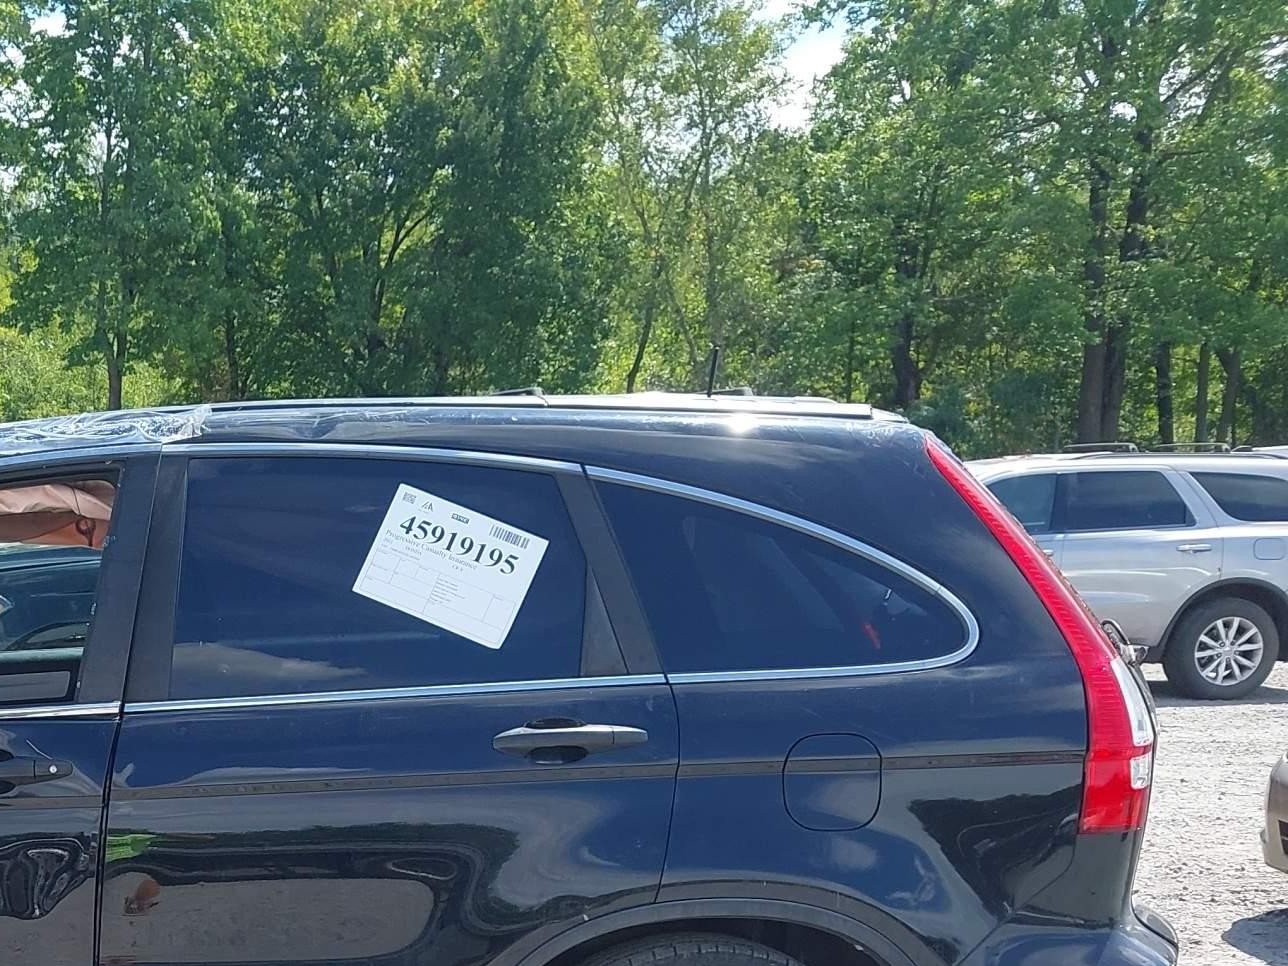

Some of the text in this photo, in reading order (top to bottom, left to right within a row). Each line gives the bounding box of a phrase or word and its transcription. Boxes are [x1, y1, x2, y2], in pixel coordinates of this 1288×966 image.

[386, 529, 421, 548] Progressive
[421, 543, 447, 560] Casualty
[399, 515, 519, 576] 45919195
